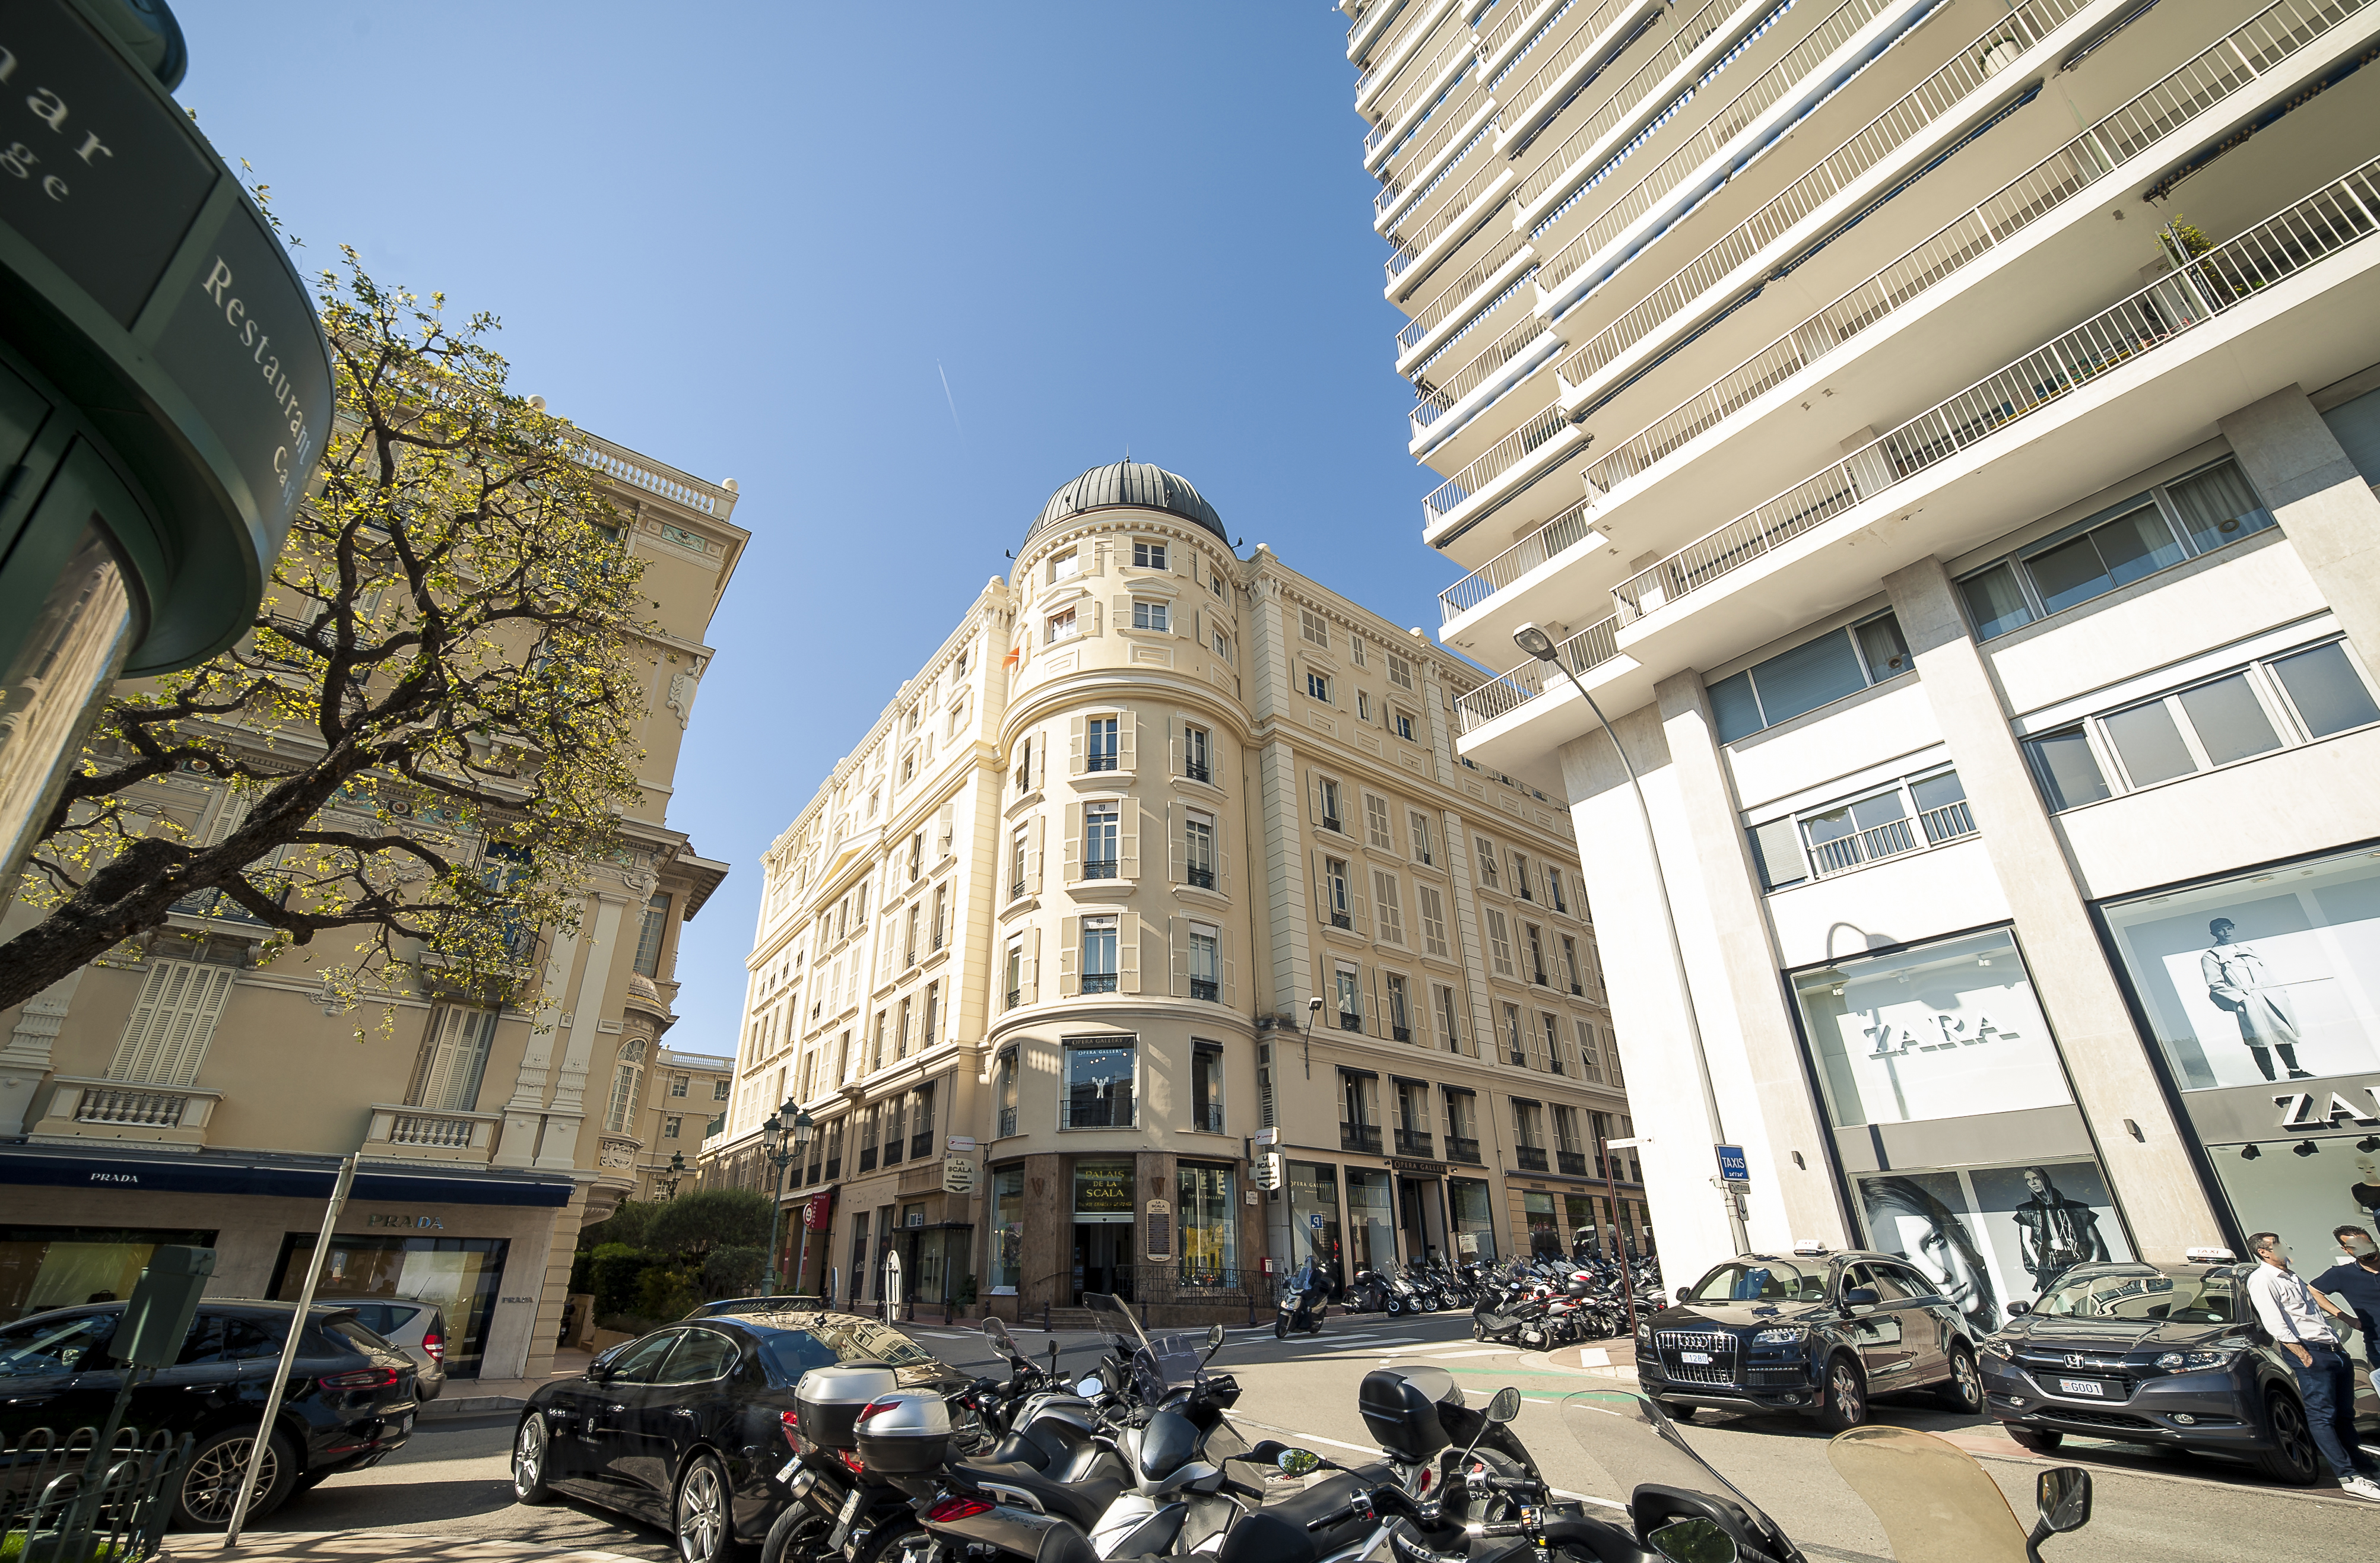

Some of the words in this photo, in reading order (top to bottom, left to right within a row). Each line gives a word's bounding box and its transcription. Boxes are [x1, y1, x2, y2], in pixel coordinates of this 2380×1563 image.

[201, 255, 310, 465] Restaurant
[1862, 1008, 2019, 1059] ZARA
[1722, 1157, 1744, 1168] TAXIS
[1420, 1164, 1447, 1172] GALLERY
[90, 1173, 138, 1183] PRADA
[1085, 1170, 1125, 1178] PALAIS
[1086, 1189, 1124, 1197] SCALA
[367, 1215, 443, 1229] PRADA
[1689, 1354, 1707, 1362] 1280
[2071, 1382, 2100, 1393] G001
